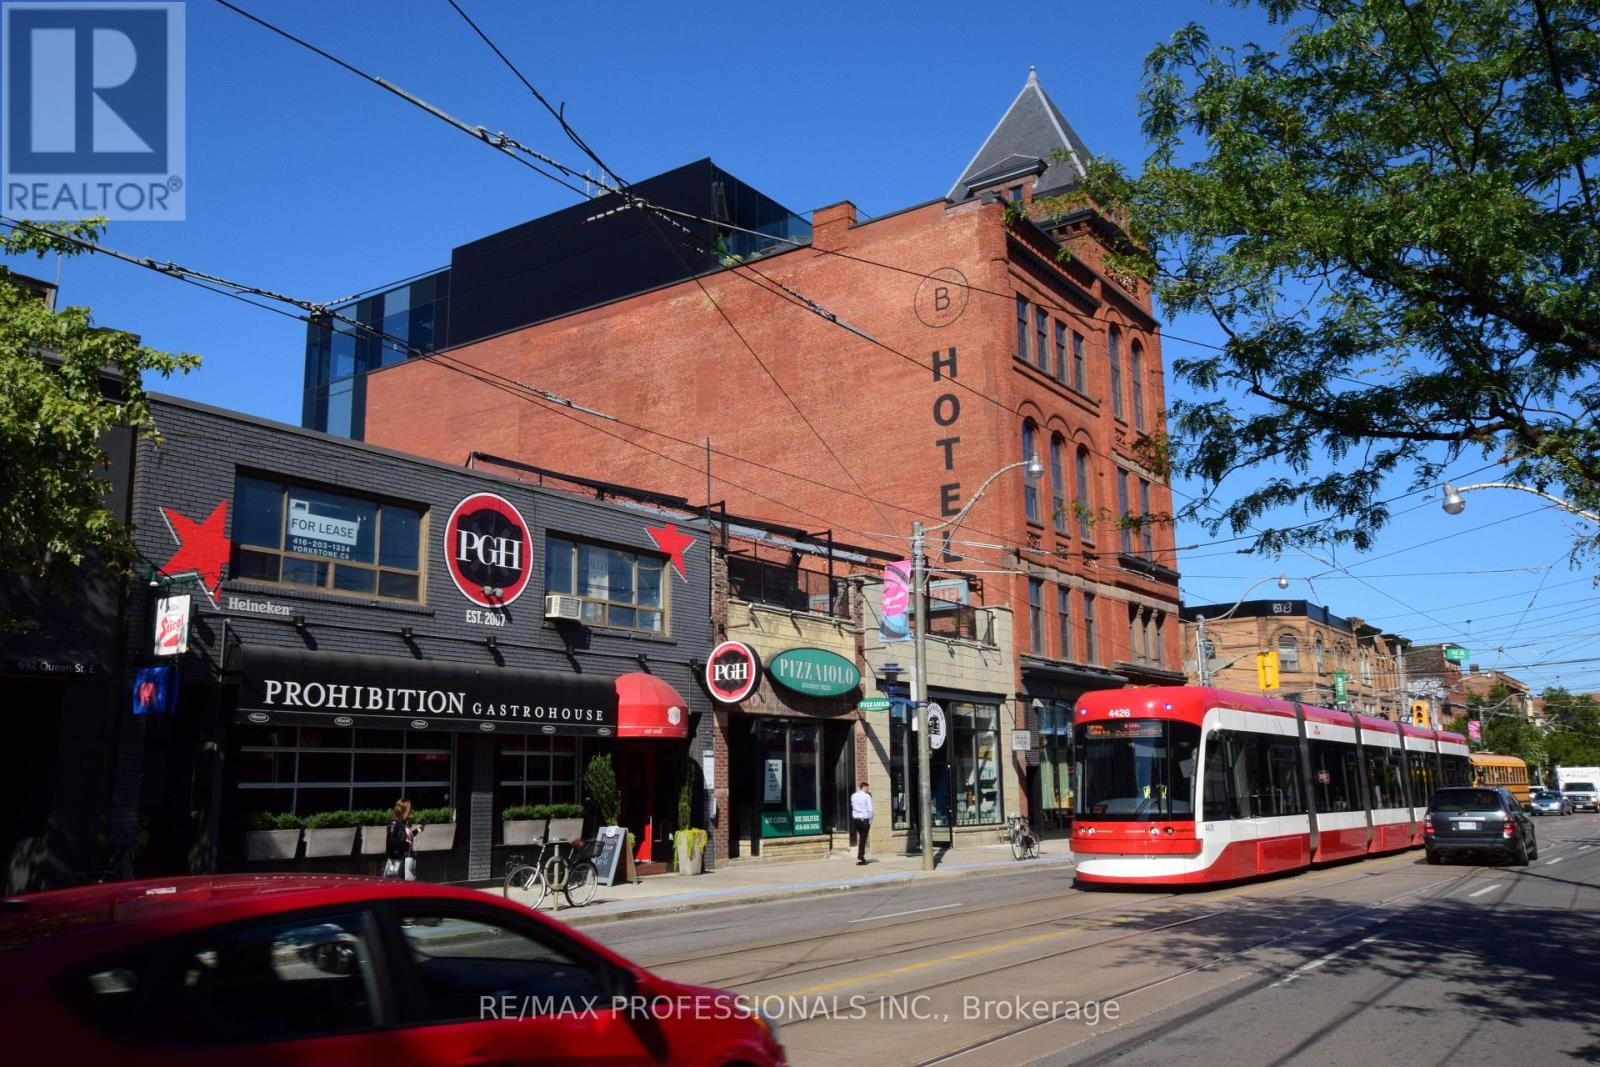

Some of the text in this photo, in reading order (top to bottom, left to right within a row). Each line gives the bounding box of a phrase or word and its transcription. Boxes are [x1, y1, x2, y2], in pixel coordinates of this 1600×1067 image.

[934, 286, 950, 311] B
[932, 347, 963, 563] HOTEL
[291, 518, 355, 539] FOR LEASE
[456, 529, 523, 570] PGH
[227, 596, 291, 616] Heineken
[466, 609, 506, 627] EST. 2007
[40, 661, 72, 673] Queen
[713, 662, 749, 681] PGH
[779, 658, 854, 686] PIZZAIOLO
[263, 679, 466, 715] PROHIBITION
[472, 702, 603, 721] GASTROHOUSE
[1108, 708, 1131, 718] 4426
